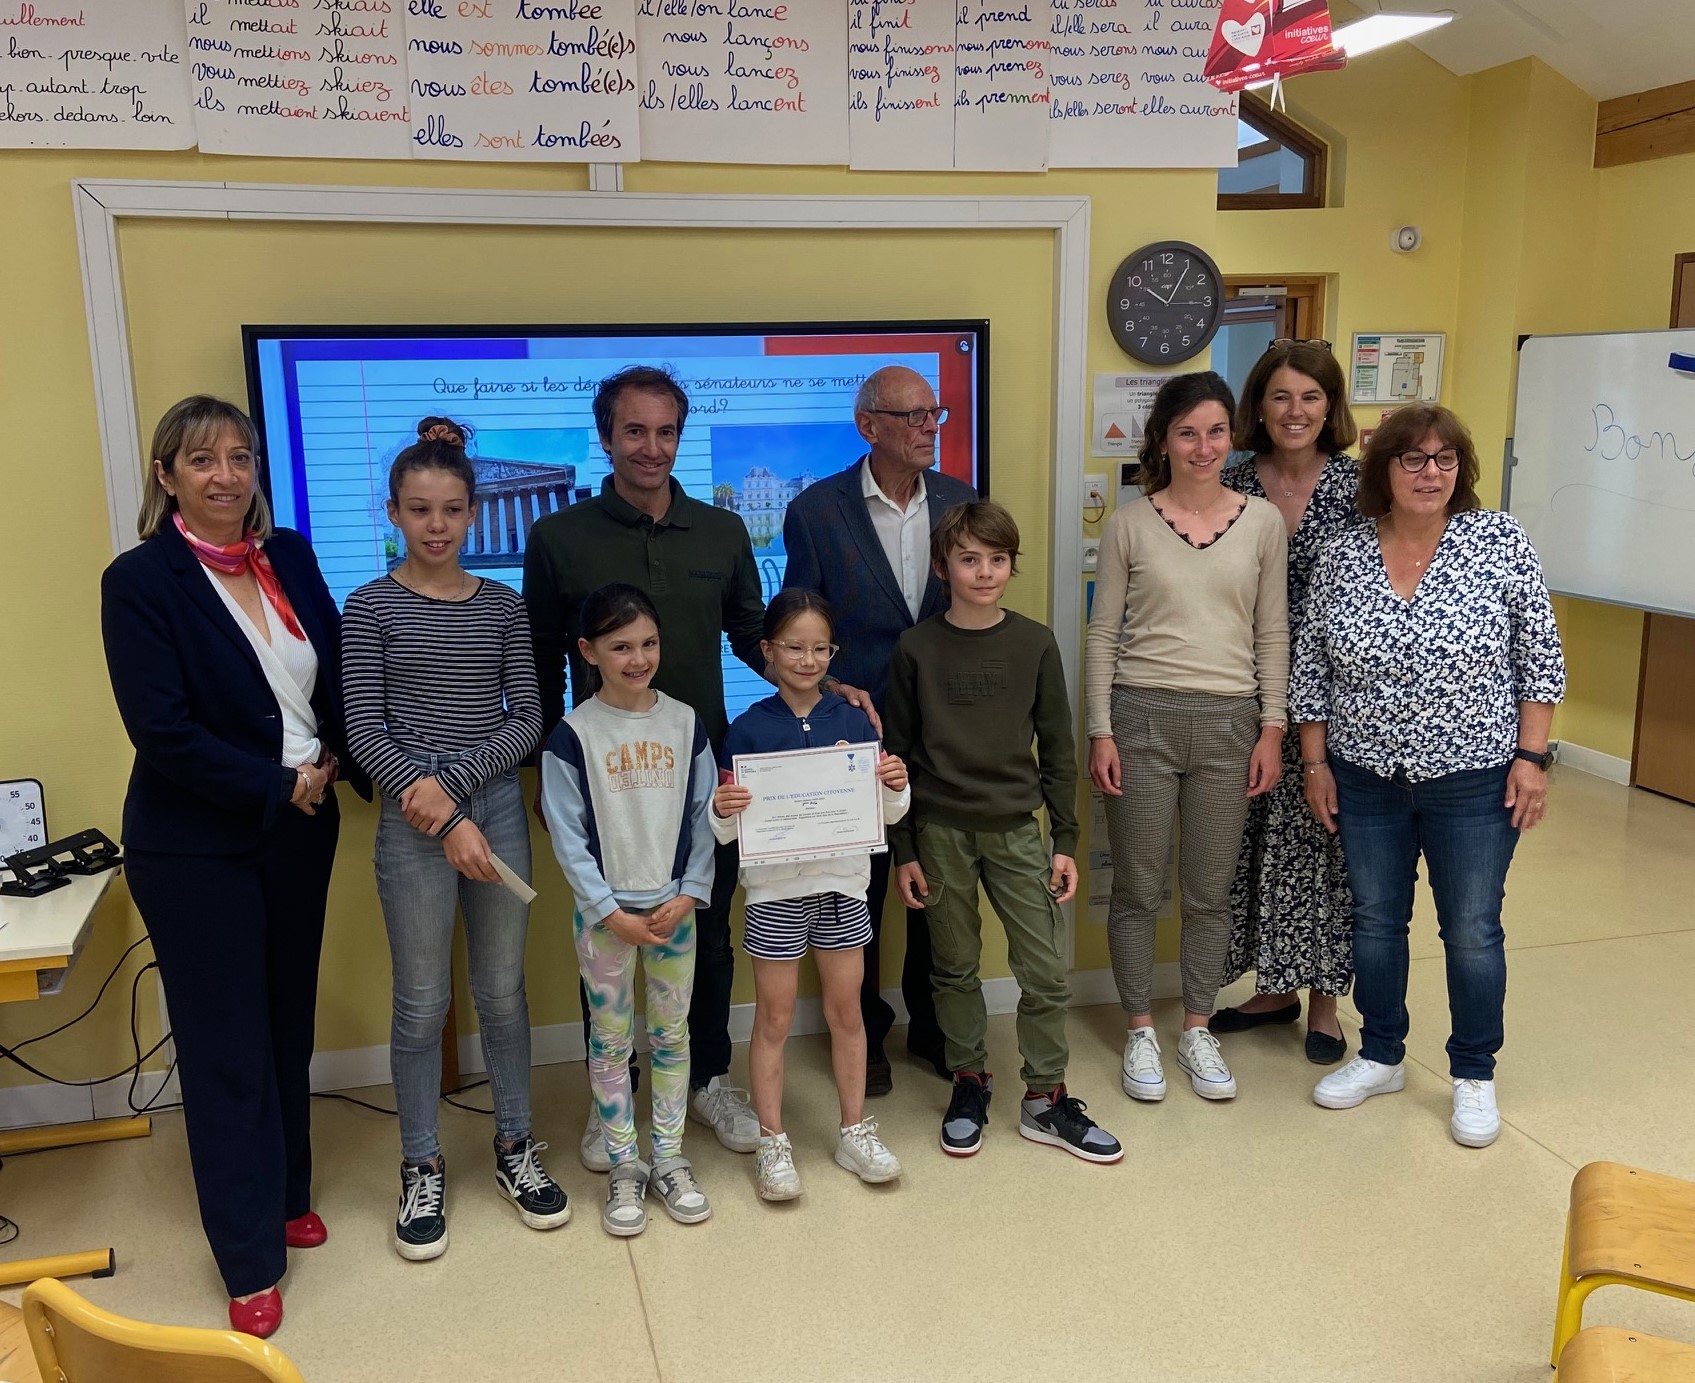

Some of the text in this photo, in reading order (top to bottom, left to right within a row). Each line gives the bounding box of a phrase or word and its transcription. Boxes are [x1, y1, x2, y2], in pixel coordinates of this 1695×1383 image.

[457, 0, 494, 19] est
[727, 0, 788, 21] lance
[956, 5, 1032, 32] il prend
[189, 2, 389, 39] il mettait skiait
[850, 7, 913, 39] il finit
[1089, 22, 1132, 35] sera
[1143, 11, 1212, 32] il aura
[408, 25, 636, 60] nous sommes tombé(e)s
[662, 22, 810, 60] nous lançons
[1284, 25, 1329, 40] initiatives
[189, 36, 232, 52] nous
[233, 45, 312, 61] mettions
[850, 35, 955, 66] nous finissons
[956, 38, 1050, 59] nous prenons
[1050, 45, 1138, 57] nous serons
[1141, 45, 1178, 56] nous
[192, 62, 236, 80] vous
[237, 74, 312, 97] mettiez
[411, 62, 636, 98] vous êtes tombé(e)s
[662, 51, 799, 89] vous lancez
[850, 56, 941, 89] vous finissez
[955, 60, 1044, 82] vous prenez
[1141, 71, 1176, 84] vous
[1050, 72, 1131, 91] vous serez
[194, 86, 411, 123] ils mettaient skiaient
[727, 84, 808, 113] lancent
[849, 86, 941, 122] ils finissent
[954, 87, 1050, 114] ils prennent
[1093, 96, 1138, 115] seront
[1139, 95, 1237, 117] elles auront
[413, 114, 464, 148] elles
[473, 129, 526, 149] sont
[1142, 260, 1154, 271] 11
[1160, 253, 1174, 265] 12
[1127, 276, 1142, 287] 10
[1197, 274, 1206, 285] 2
[1120, 298, 1130, 310] 9
[1203, 296, 1212, 307] 3
[1125, 320, 1135, 332] 8
[1196, 318, 1205, 329] 4
[1139, 337, 1148, 348] 7
[1160, 343, 1170, 354] 6
[1182, 335, 1191, 346] 5
[433, 377, 468, 394] Que
[473, 376, 516, 400] faire
[521, 379, 538, 393] si
[543, 376, 569, 391] les
[694, 376, 777, 390] sénateurs
[782, 377, 804, 389] ne
[808, 378, 827, 388] se
[831, 373, 867, 388] mett
[1126, 377, 1167, 387] Les triangle
[1584, 403, 1695, 461] Bon
[606, 740, 675, 775] CAMPS
